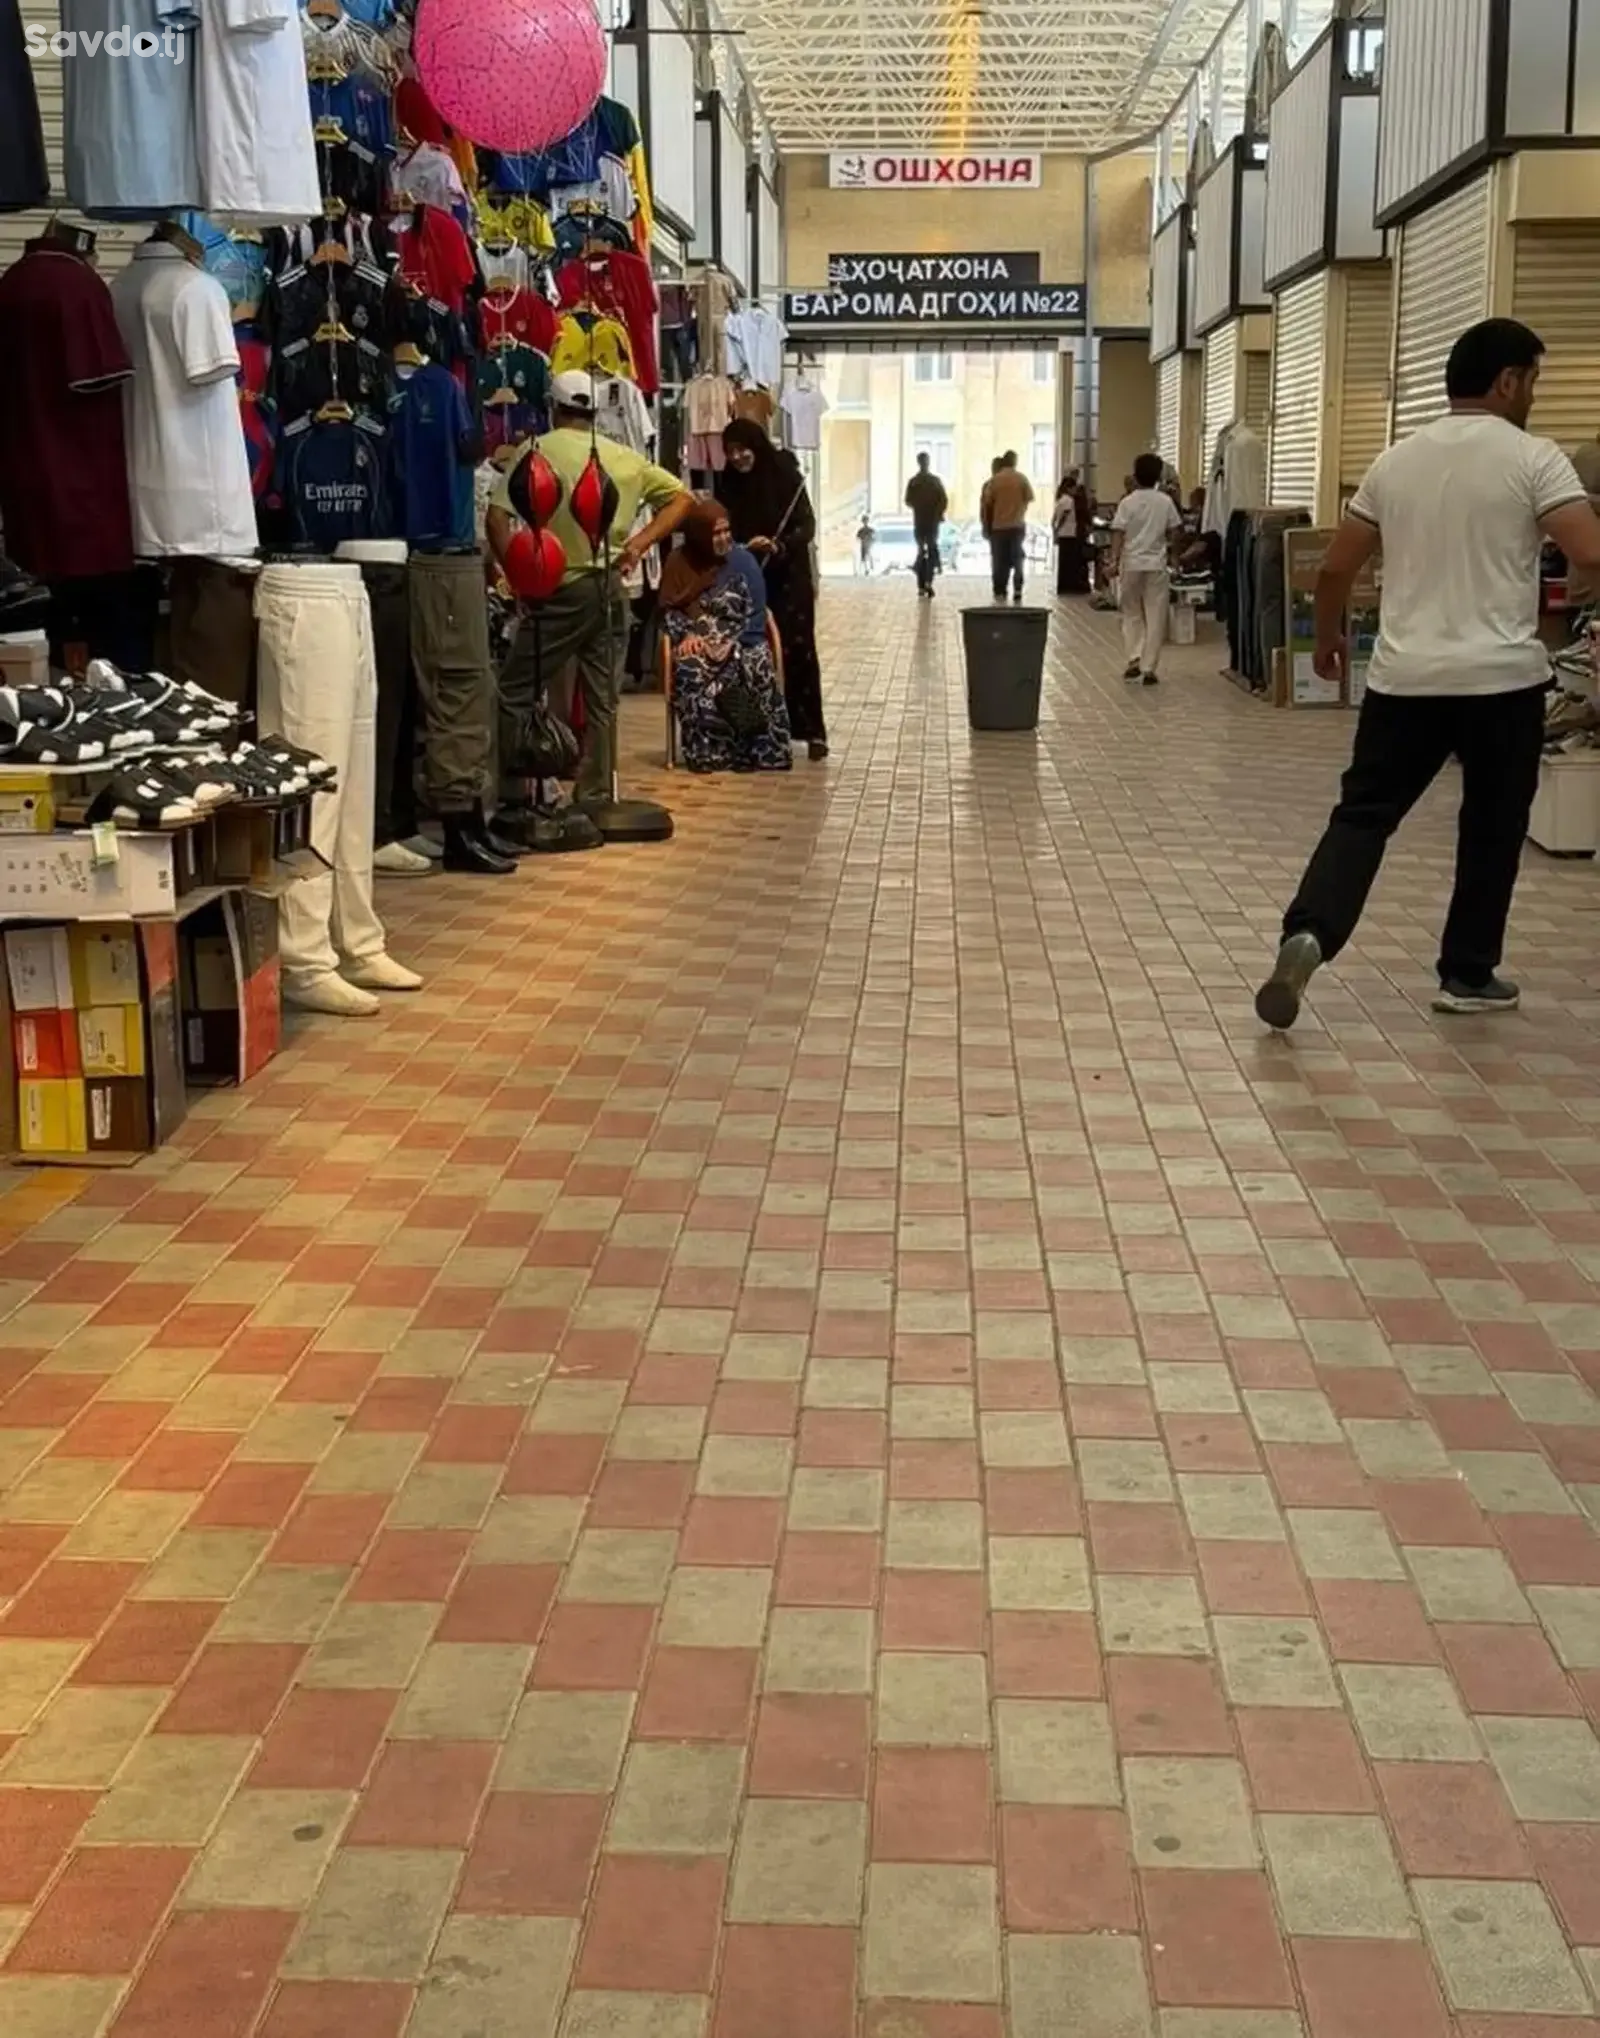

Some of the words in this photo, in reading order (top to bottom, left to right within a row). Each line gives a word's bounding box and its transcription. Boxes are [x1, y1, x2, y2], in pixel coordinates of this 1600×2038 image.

[873, 157, 1032, 182] ОШХОНА
[790, 290, 1017, 319] БАРОМАДГОҲИ
[1022, 290, 1080, 313] №22
